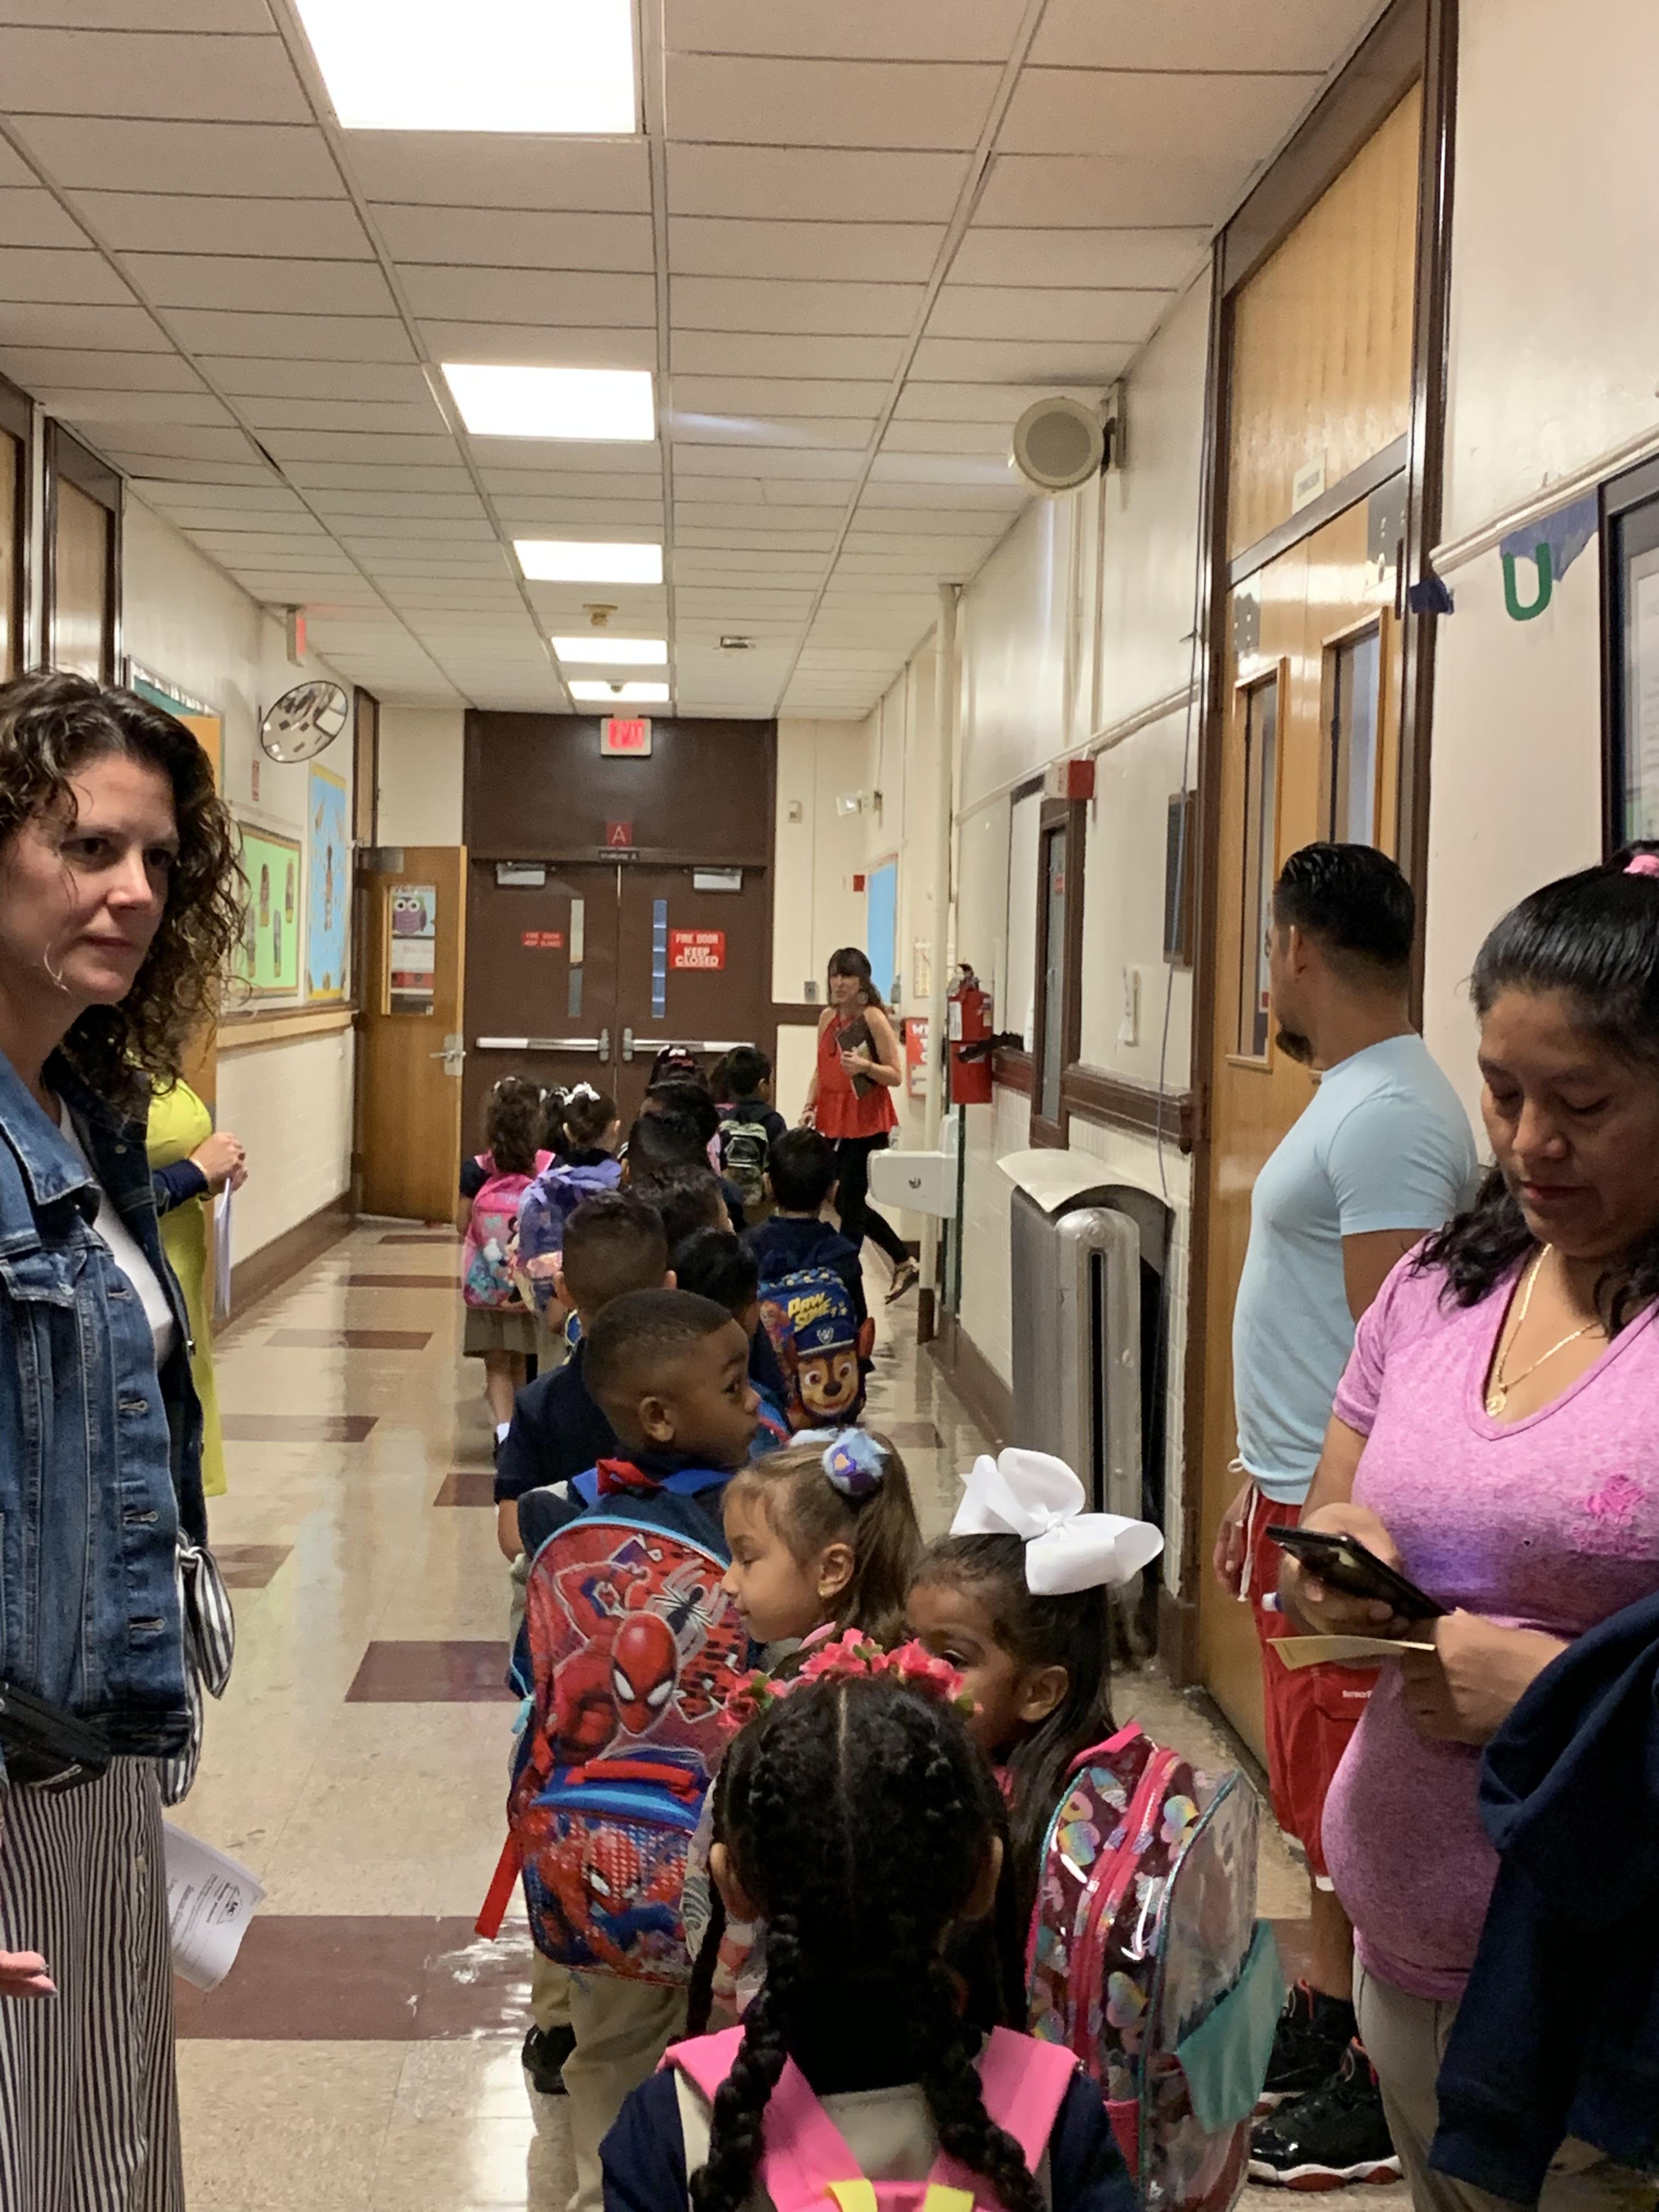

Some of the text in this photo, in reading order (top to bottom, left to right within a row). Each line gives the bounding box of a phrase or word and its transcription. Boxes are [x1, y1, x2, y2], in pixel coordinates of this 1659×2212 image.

[1502, 542, 1552, 621] U
[608, 720, 644, 748] EXIT
[611, 825, 627, 844] A
[675, 933, 719, 944] FIRE DOOR
[684, 947, 710, 957] KEEP
[675, 955, 719, 967] CLOSED
